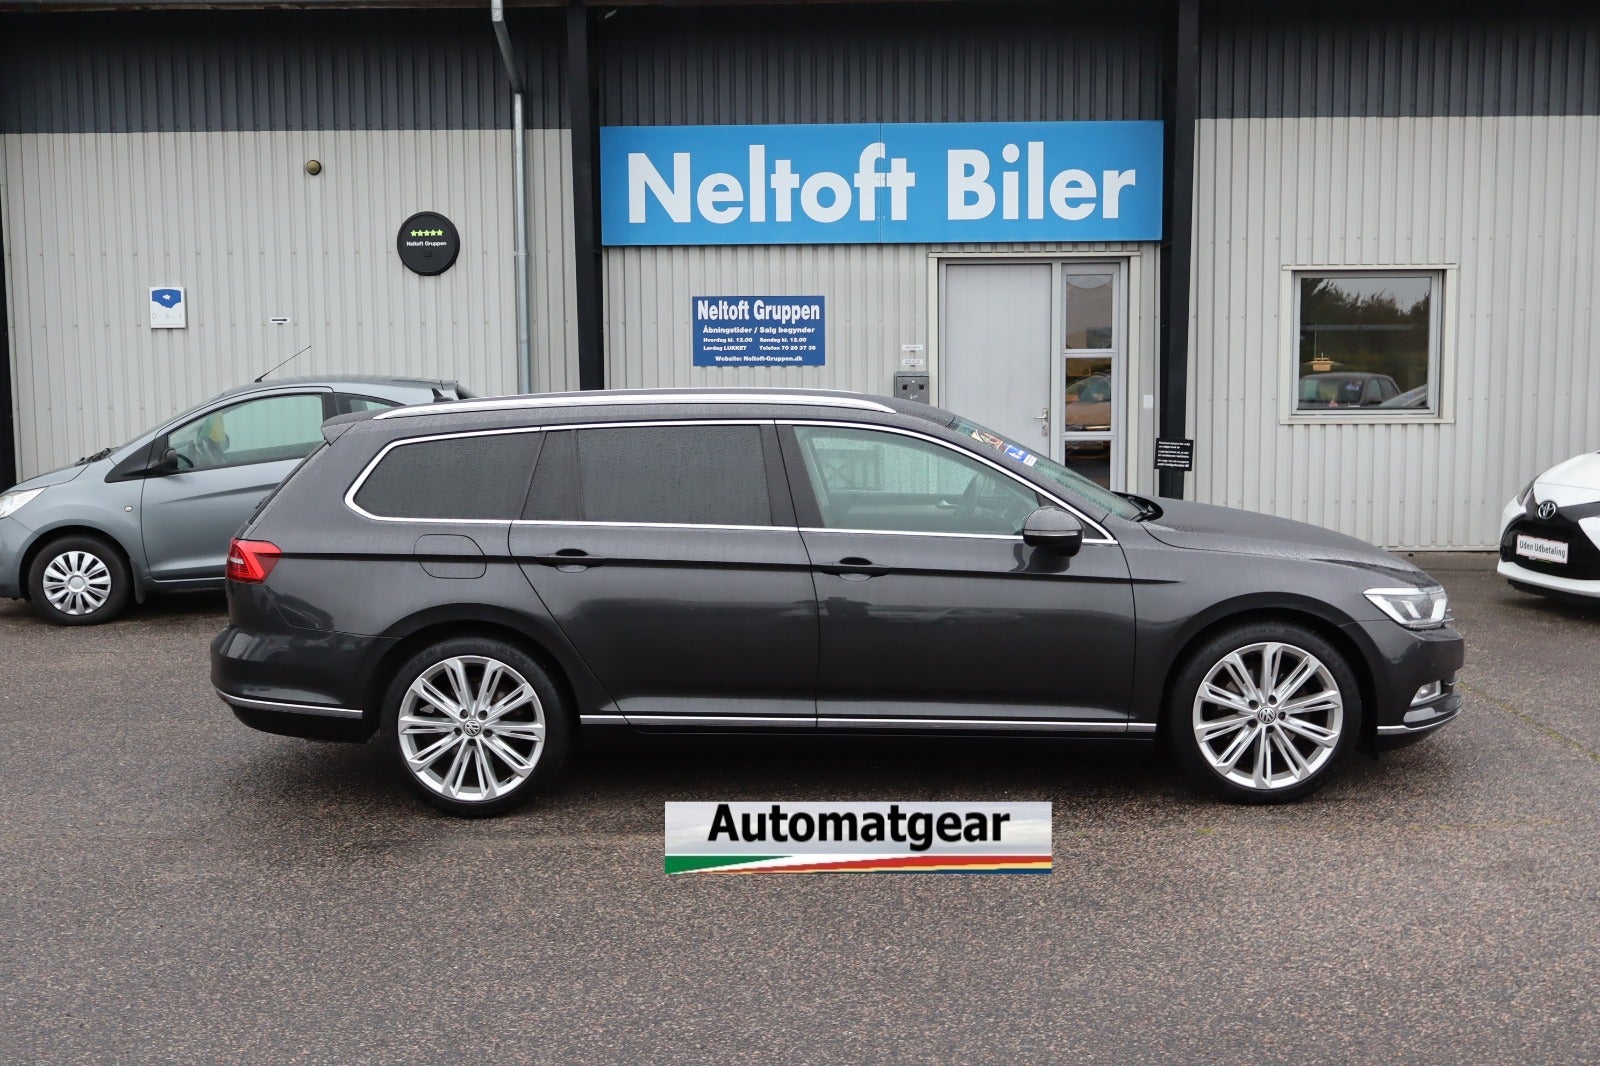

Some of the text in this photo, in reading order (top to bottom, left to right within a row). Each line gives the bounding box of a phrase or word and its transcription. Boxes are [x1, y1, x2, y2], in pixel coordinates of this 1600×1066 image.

[628, 141, 1136, 224] Neltoft Biler
[697, 299, 820, 324] Neltoft Gruppen
[703, 324, 752, 335] Åbningstider
[759, 326, 777, 335] Salg
[778, 326, 815, 335] begynder
[1519, 540, 1566, 558] Uden Udbetaling
